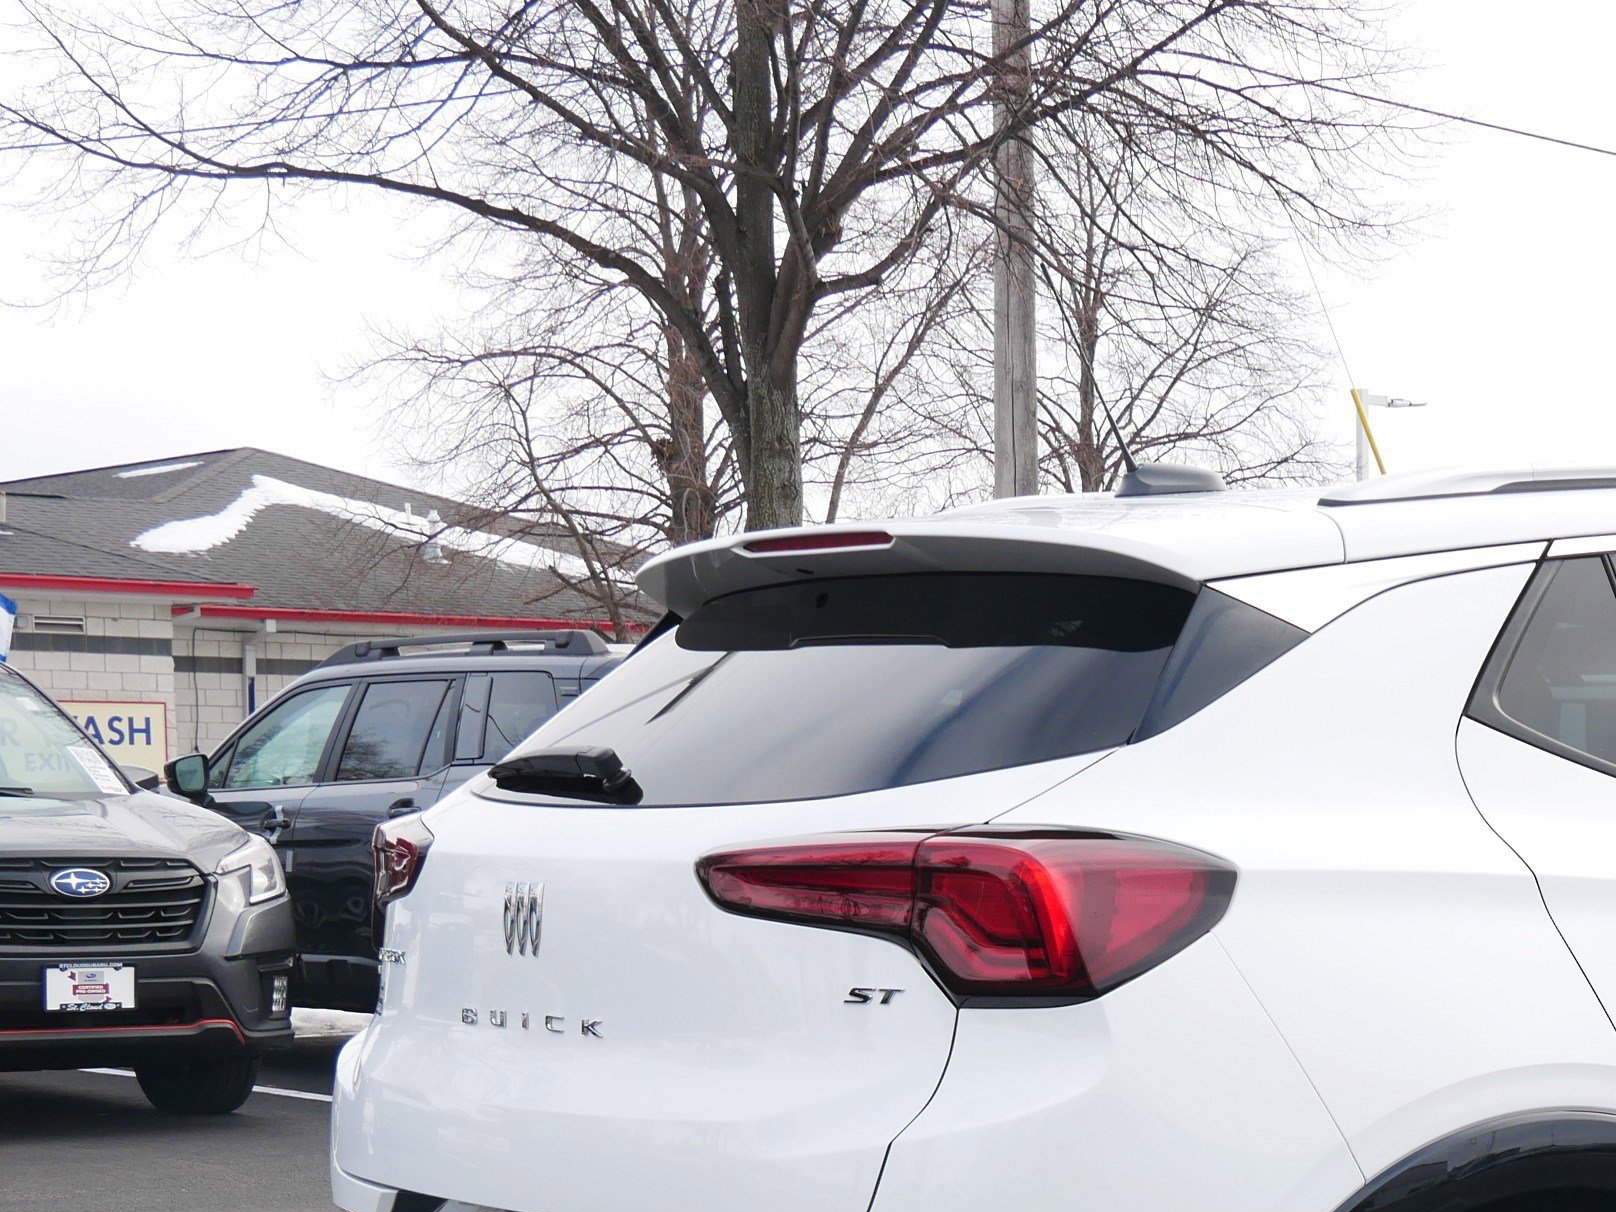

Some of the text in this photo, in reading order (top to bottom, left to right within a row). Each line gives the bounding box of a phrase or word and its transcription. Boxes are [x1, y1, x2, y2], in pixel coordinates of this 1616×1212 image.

[71, 715, 151, 746] ASH
[843, 987, 905, 1005] ST
[461, 1008, 604, 1039] BUICK
